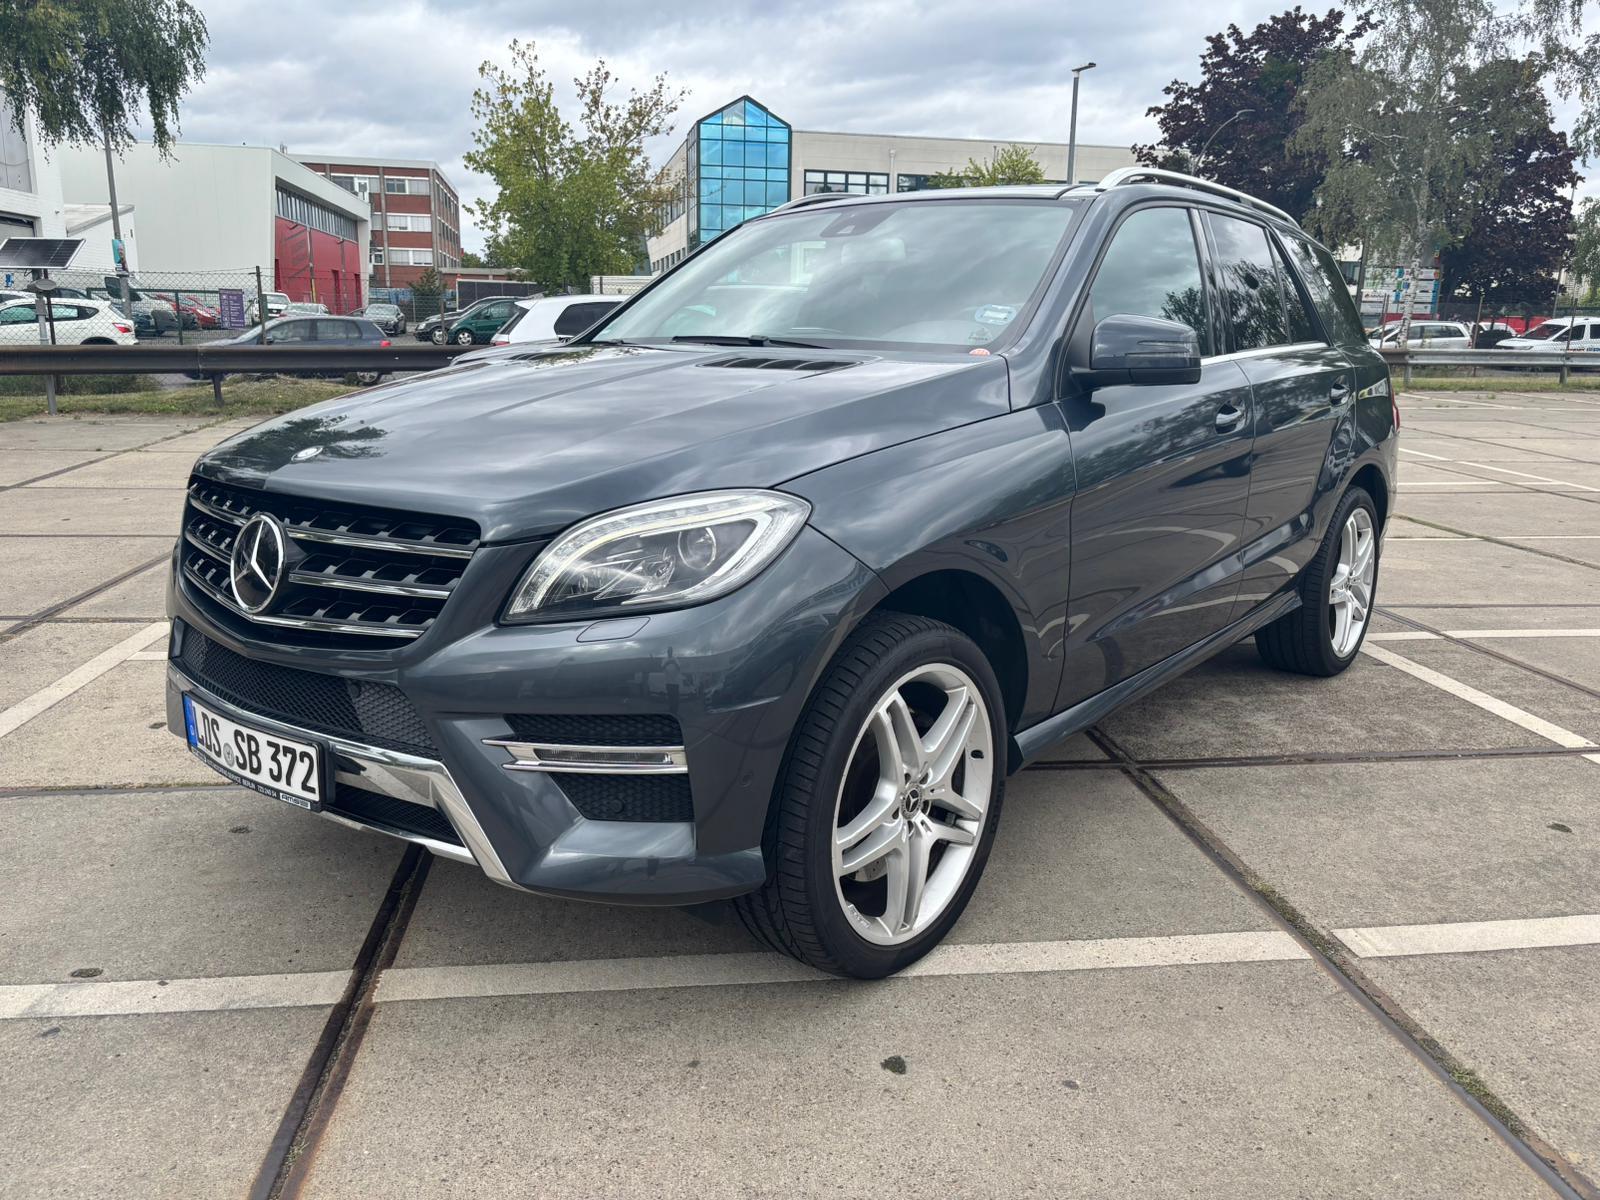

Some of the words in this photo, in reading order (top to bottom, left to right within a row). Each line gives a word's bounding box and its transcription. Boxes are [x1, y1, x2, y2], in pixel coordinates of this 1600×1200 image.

[192, 706, 221, 758] LDS
[234, 729, 261, 775] SB
[267, 740, 316, 794] 372
